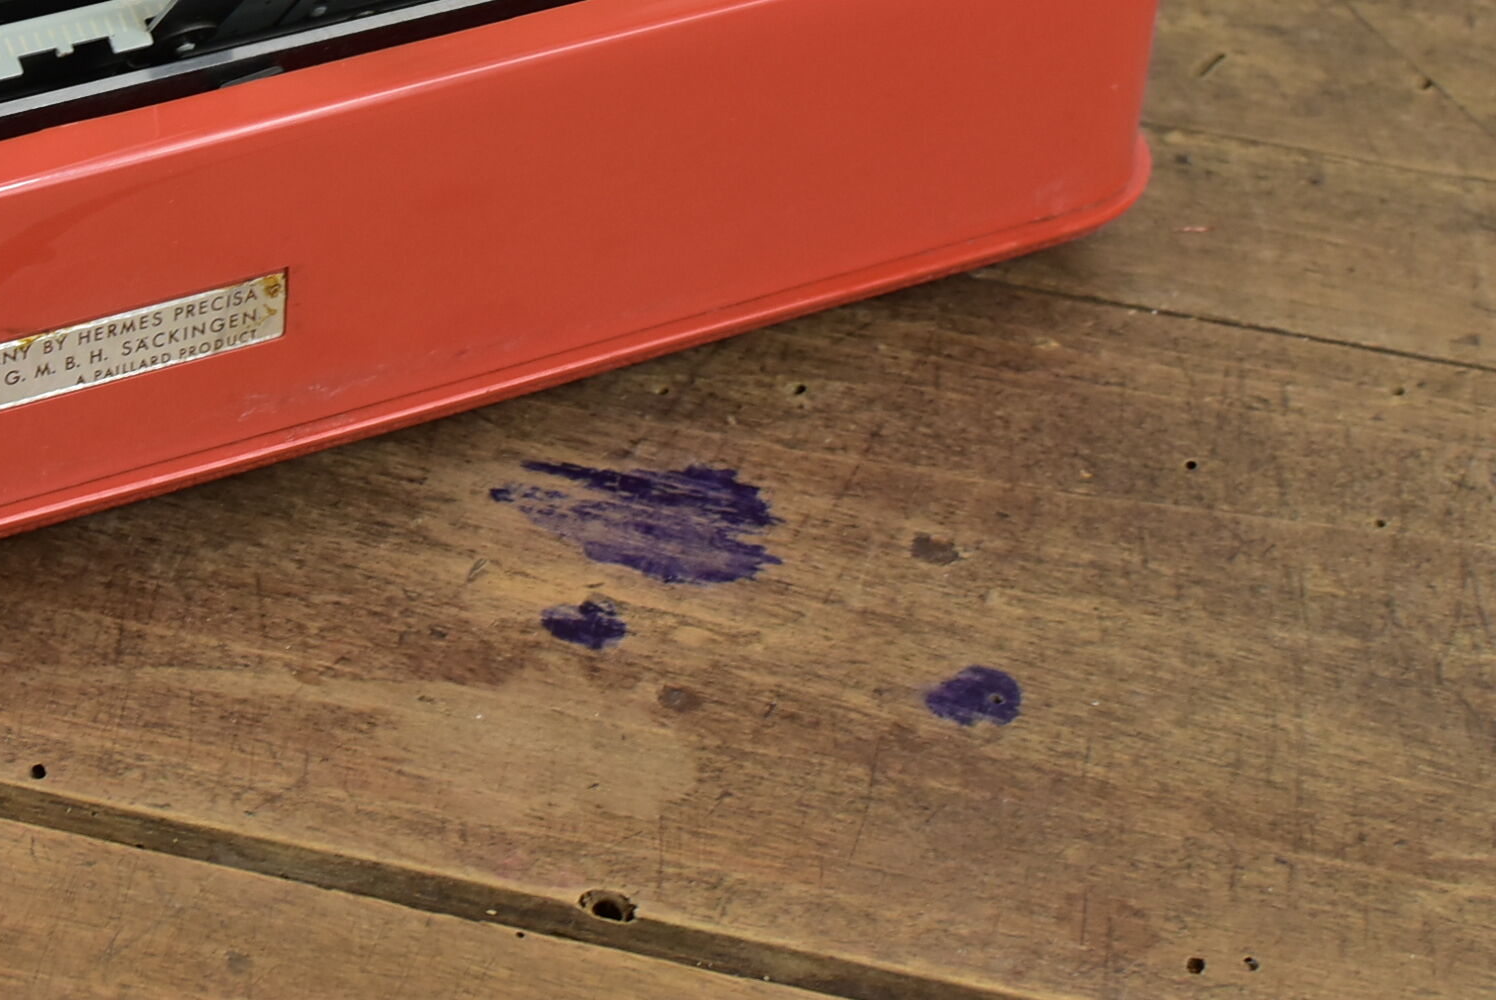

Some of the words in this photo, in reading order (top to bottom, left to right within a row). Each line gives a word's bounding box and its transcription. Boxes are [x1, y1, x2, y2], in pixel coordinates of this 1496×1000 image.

[4, 370, 26, 387] G.
[34, 363, 57, 380] M.
[64, 355, 81, 372] B.
[89, 347, 109, 365] H.
[121, 308, 258, 357] SÄCKINGEN
[44, 335, 69, 356] BY
[77, 310, 163, 347] HERMES
[173, 287, 258, 322] PRECISA
[75, 374, 86, 386] A
[94, 351, 172, 382] PAILLARD
[178, 328, 258, 360] PRODUCT
